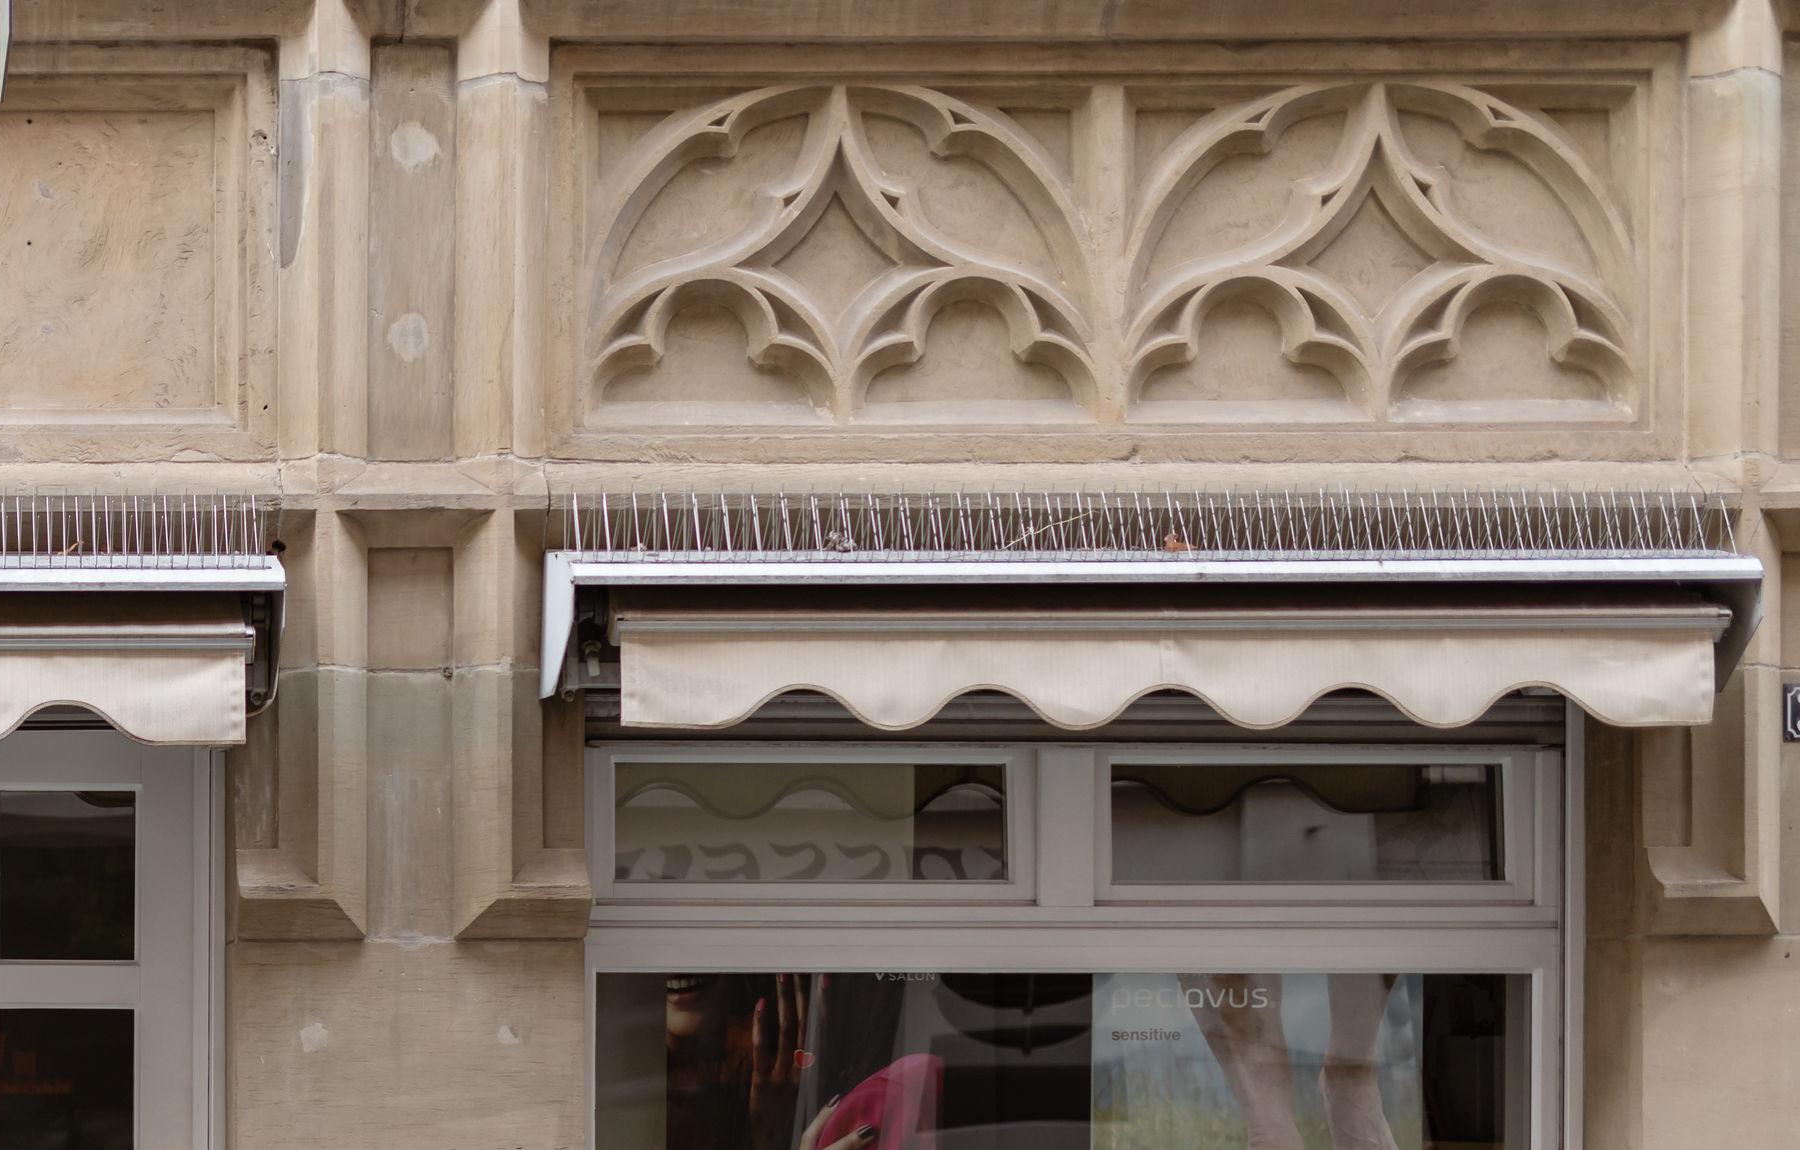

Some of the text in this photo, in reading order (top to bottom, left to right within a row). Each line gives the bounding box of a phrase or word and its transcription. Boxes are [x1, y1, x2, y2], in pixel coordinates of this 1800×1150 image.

[889, 972, 935, 981] SALON
[1112, 981, 1268, 1015] peclavus
[1112, 1028, 1182, 1041] sensitive
